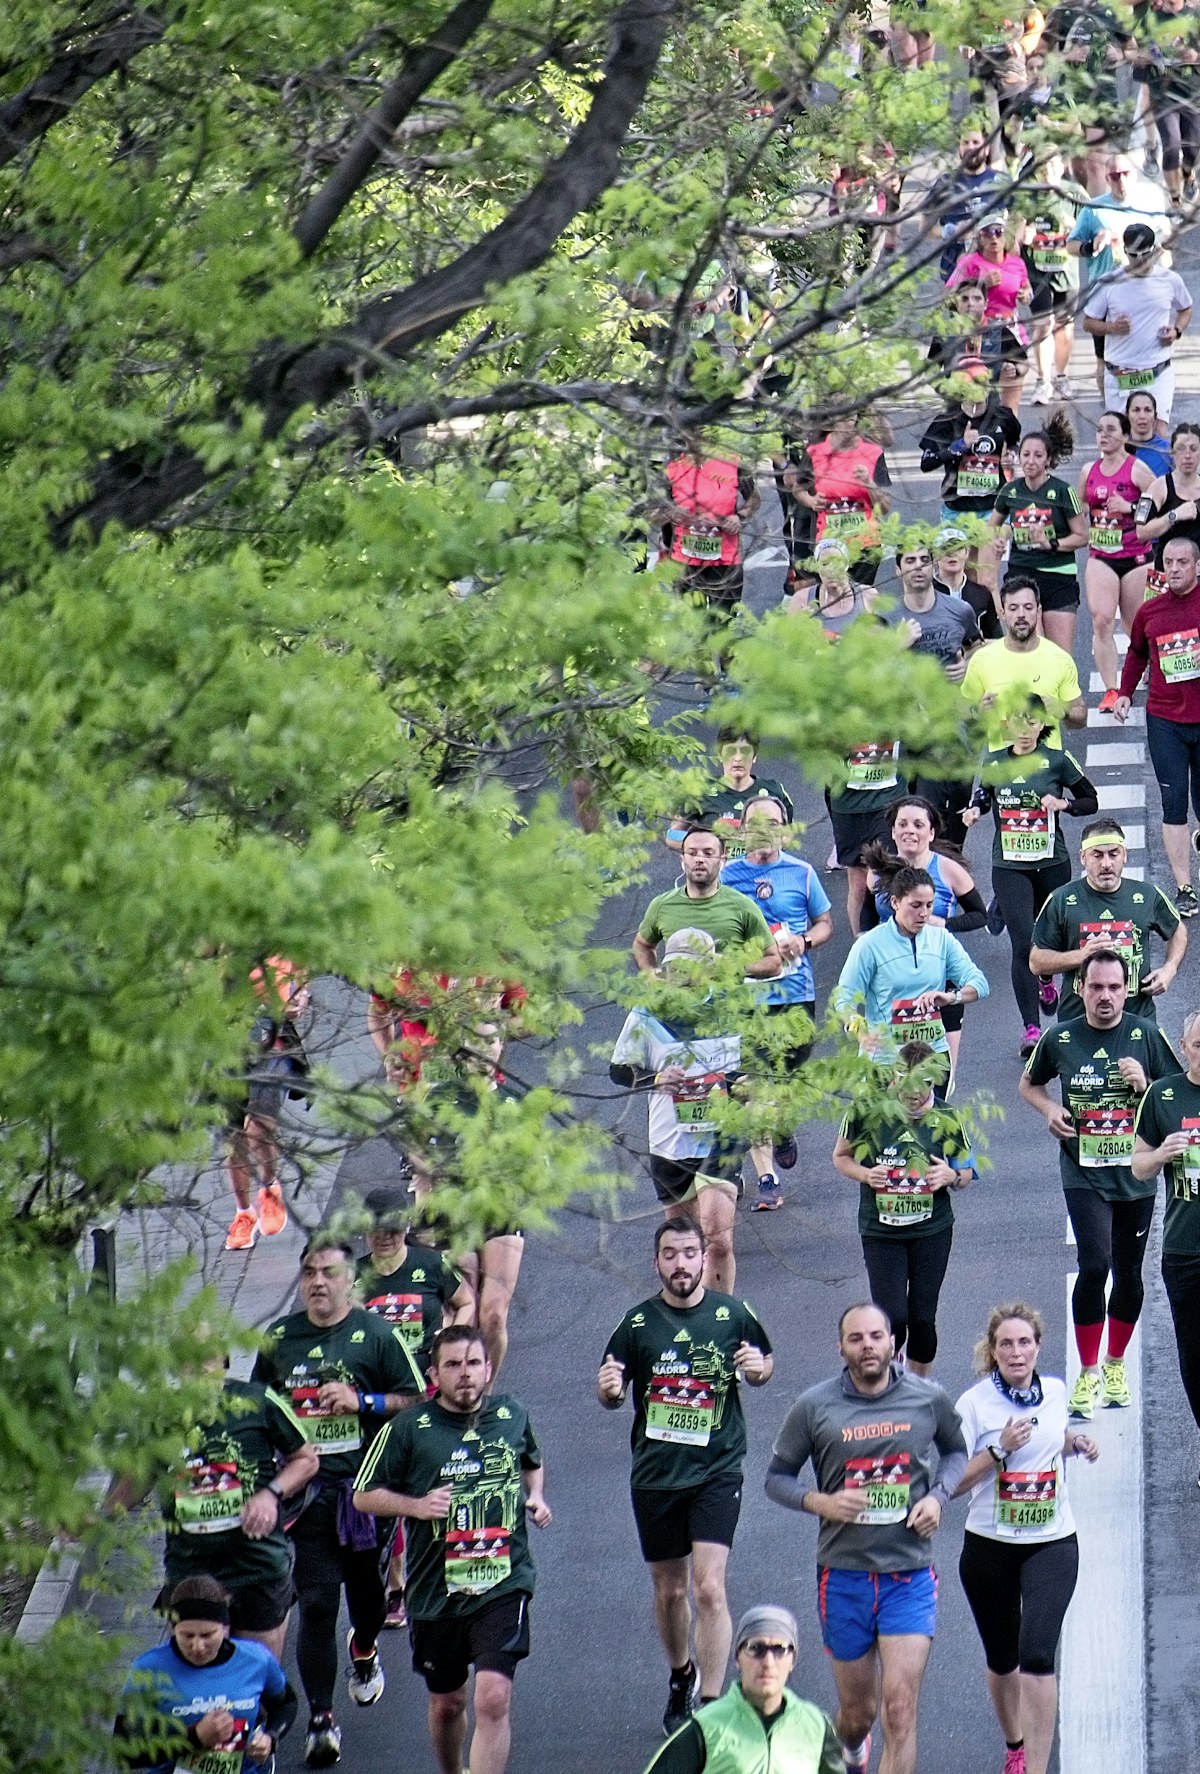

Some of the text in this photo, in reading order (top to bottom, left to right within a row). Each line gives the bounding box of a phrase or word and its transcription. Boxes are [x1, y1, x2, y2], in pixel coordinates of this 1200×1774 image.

[1173, 656, 1196, 670] 40850
[1011, 837, 1040, 850] F41915
[1080, 1064, 1095, 1075] edp
[1070, 1077, 1104, 1087] MADRID
[1101, 1111, 1113, 1120] edp
[884, 1147, 897, 1157] edp
[1097, 1142, 1125, 1156] 42804
[661, 1350, 677, 1363] edp
[652, 1365, 690, 1376] MADRID
[668, 1412, 699, 1429] 42859
[316, 1422, 347, 1439] 42384
[452, 1450, 468, 1462] edp
[440, 1465, 481, 1477] MADRID
[865, 1492, 897, 1509] 2630
[1009, 1506, 1047, 1524] F41439
[467, 1563, 499, 1581] 41500
